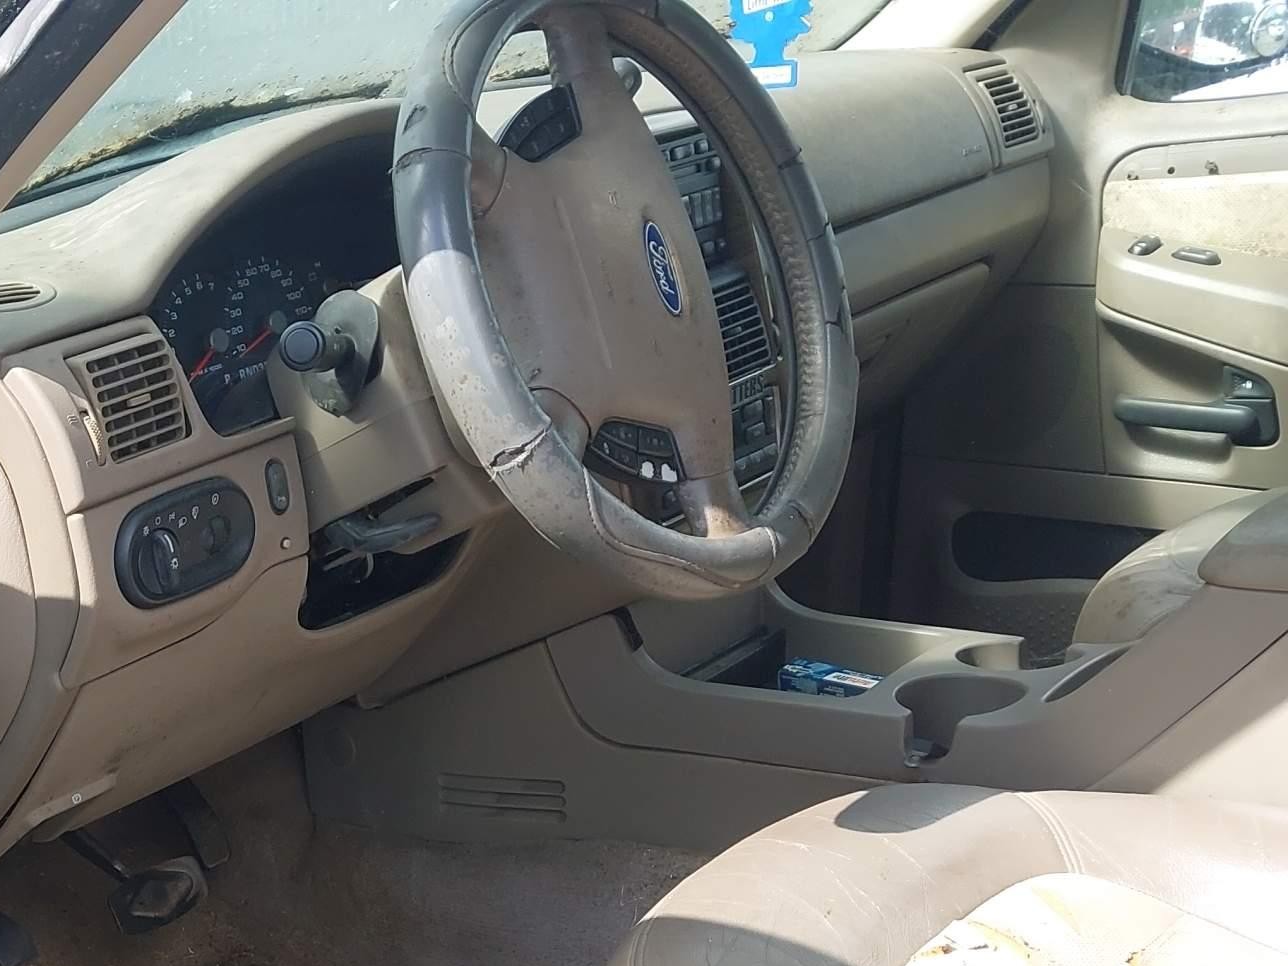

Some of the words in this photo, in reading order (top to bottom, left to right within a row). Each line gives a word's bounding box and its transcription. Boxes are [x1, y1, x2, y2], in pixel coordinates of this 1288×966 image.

[258, 263, 270, 272] 70
[650, 241, 675, 295] Ford
[238, 278, 250, 288] 50
[232, 292, 244, 300] 40
[230, 308, 242, 318] 30
[231, 325, 243, 335] 20
